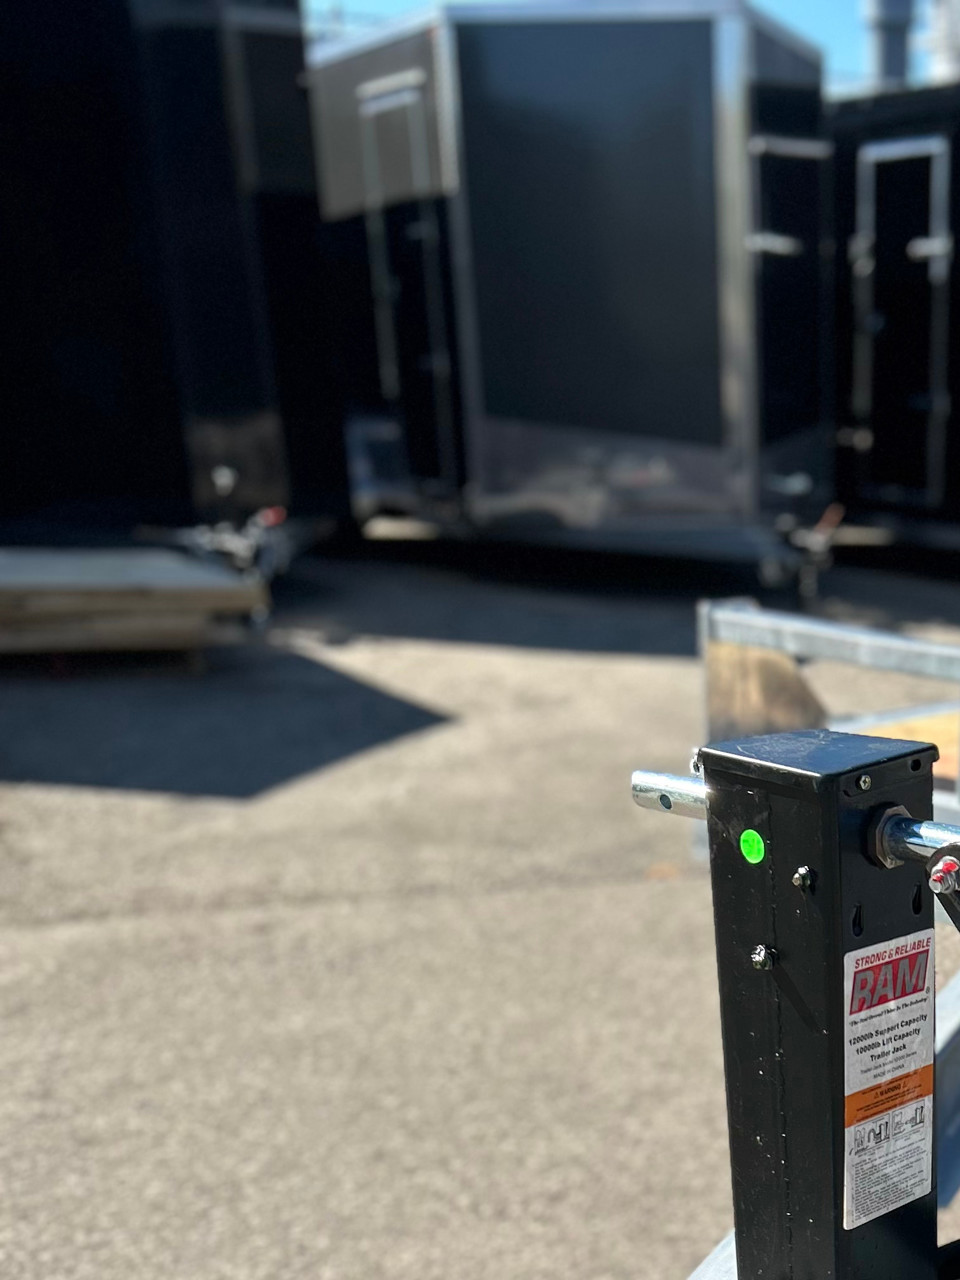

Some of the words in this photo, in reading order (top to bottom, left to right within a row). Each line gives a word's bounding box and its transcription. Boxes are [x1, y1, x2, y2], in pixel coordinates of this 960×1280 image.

[855, 950, 887, 969] STRONG
[888, 948, 894, 959] &
[895, 937, 931, 957] RELIABLE
[851, 951, 928, 1013] RAM
[874, 1023, 899, 1037] Support
[900, 1014, 928, 1028] Capacity
[893, 1027, 921, 1041] Capacity
[870, 1049, 891, 1062] Trailer
[892, 1043, 907, 1054] Jack
